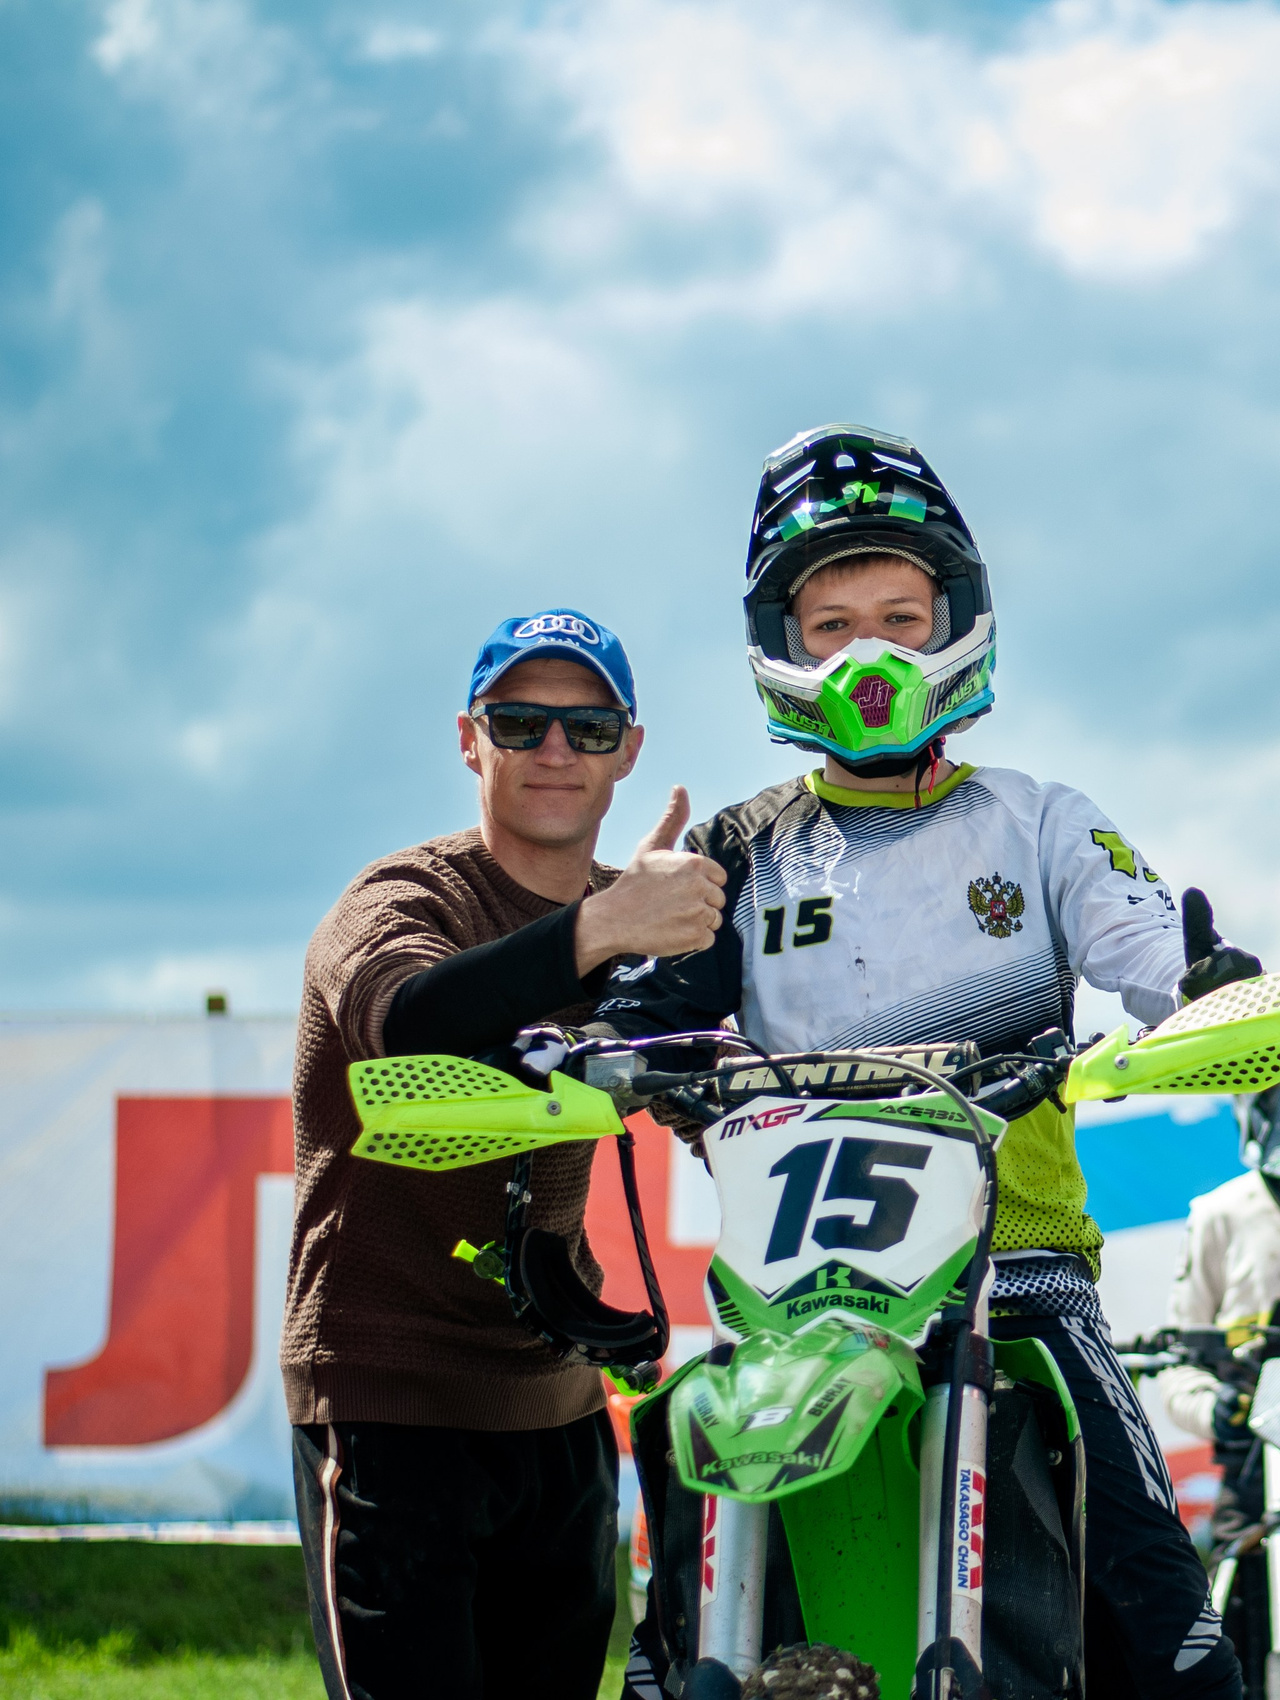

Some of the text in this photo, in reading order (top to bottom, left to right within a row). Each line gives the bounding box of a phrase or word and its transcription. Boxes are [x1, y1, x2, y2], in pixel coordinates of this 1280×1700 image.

[858, 681, 890, 708] J1
[762, 896, 834, 956] 15
[719, 1103, 808, 1141] MXGP
[764, 1137, 933, 1265] 15
[786, 1293, 890, 1320] Kawasaki
[701, 1450, 822, 1478] Kawasaki
[957, 1468, 971, 1589] TAKASAGO CHAIN
